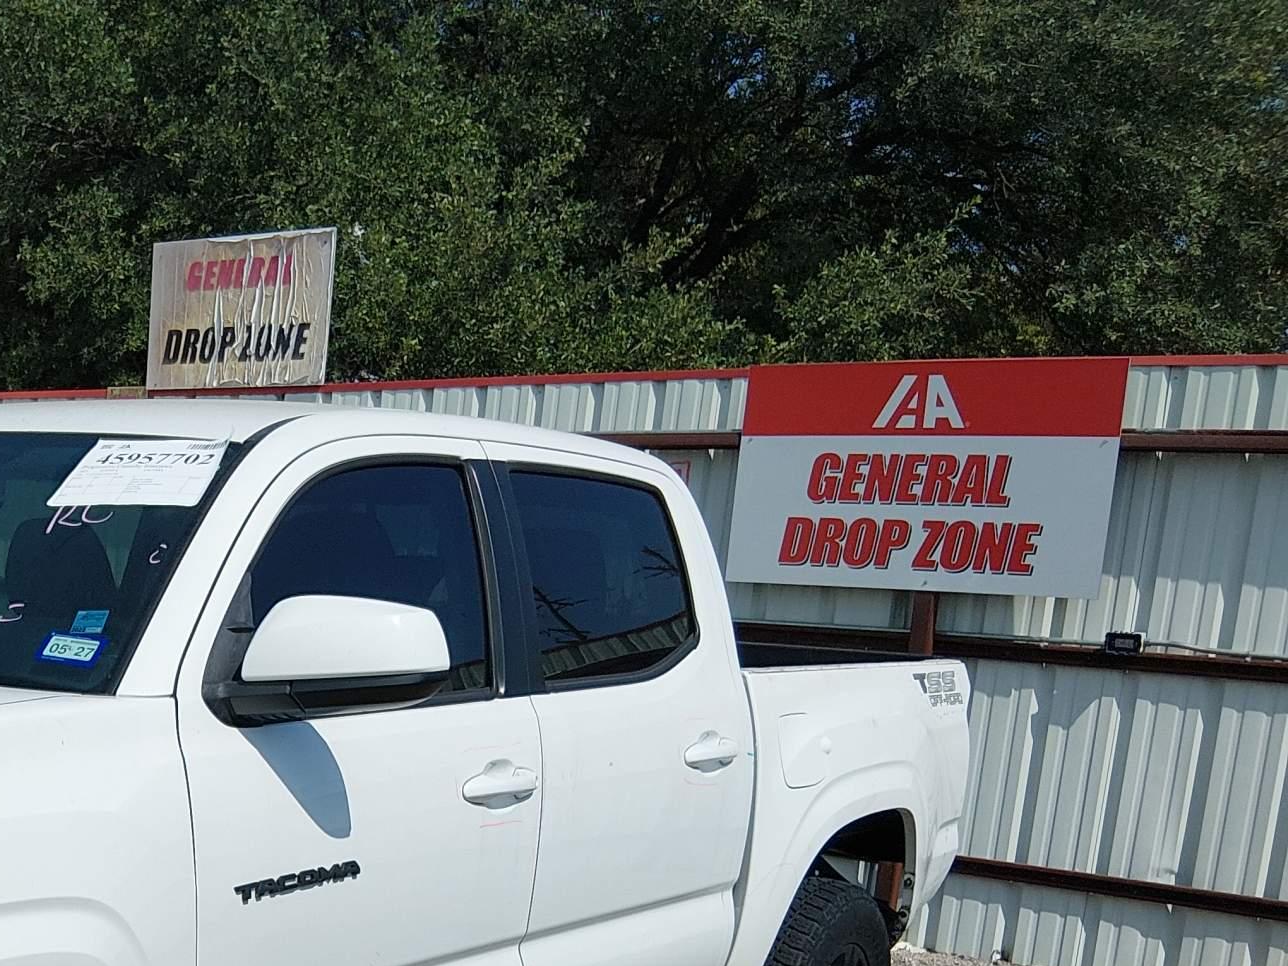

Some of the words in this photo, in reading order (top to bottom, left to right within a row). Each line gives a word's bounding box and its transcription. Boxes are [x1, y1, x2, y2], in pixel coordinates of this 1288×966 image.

[186, 256, 292, 291] GENERAL
[162, 327, 235, 365] DROP
[238, 322, 310, 364] ZONE
[96, 453, 216, 465] 45957702
[807, 452, 1012, 507] GENERAL
[777, 516, 912, 570] DROP
[911, 520, 1044, 577] ZONE
[73, 646, 96, 658] 27
[233, 860, 361, 906] TACOMA
